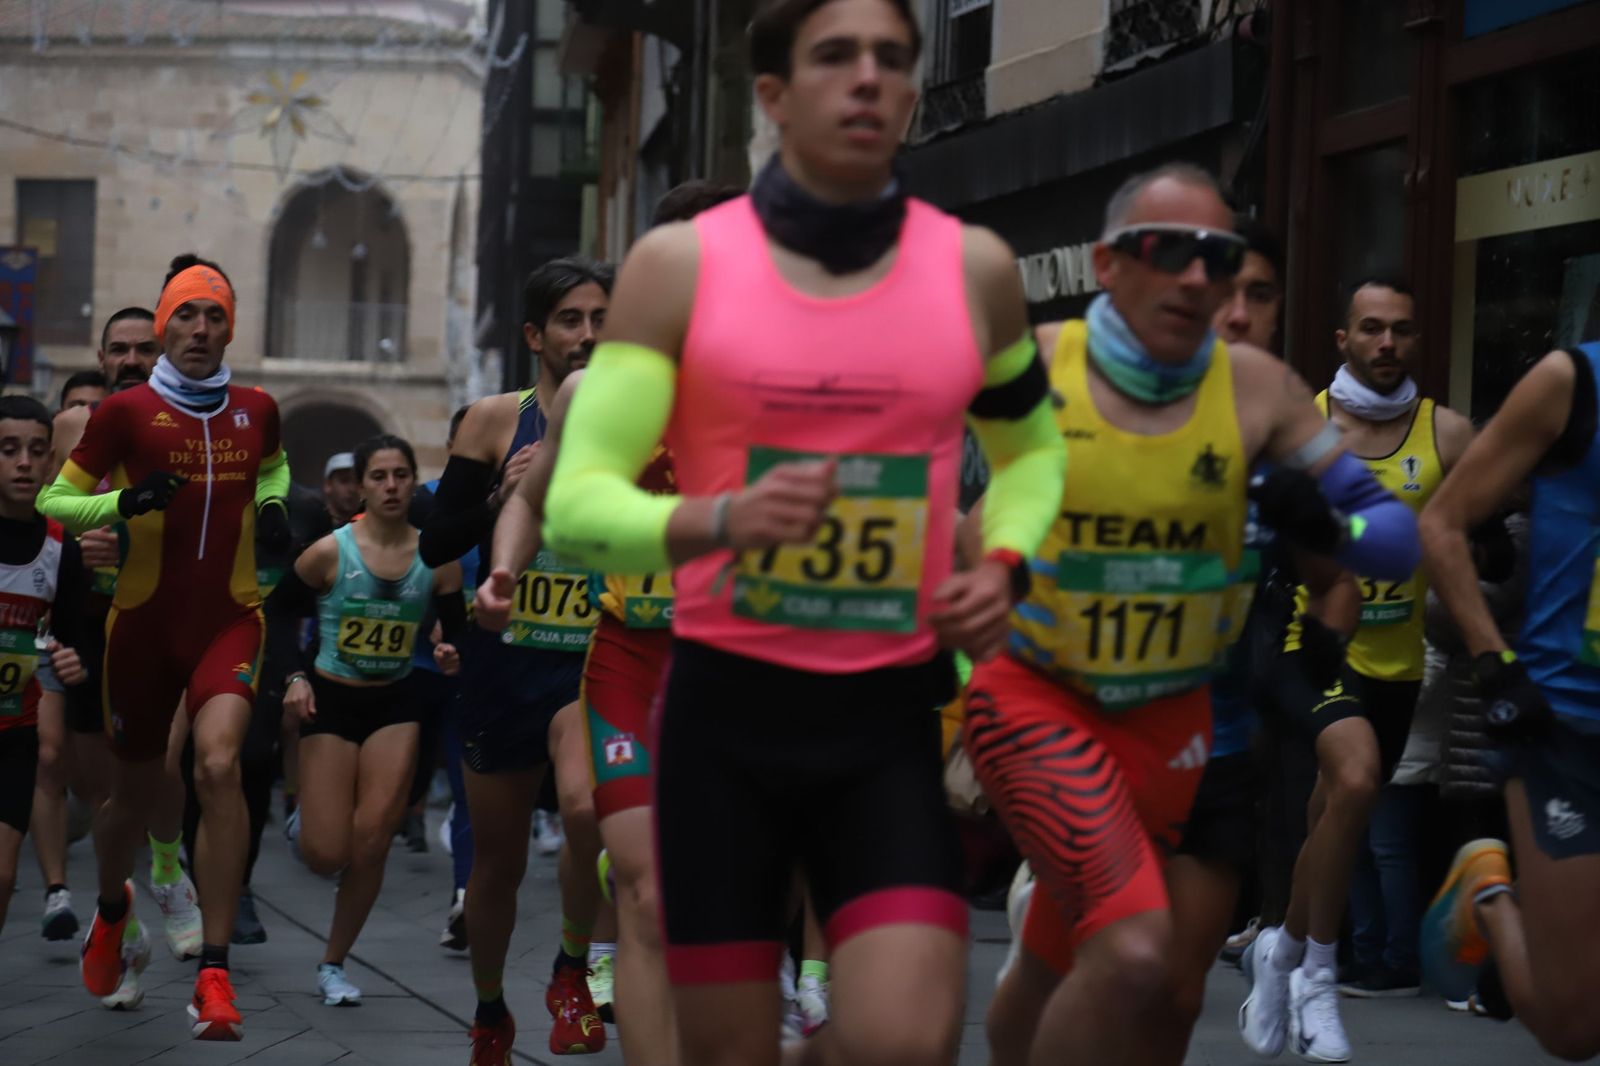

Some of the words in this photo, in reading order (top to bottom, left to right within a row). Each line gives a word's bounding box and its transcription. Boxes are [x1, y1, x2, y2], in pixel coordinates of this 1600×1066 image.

[169, 451, 192, 464] DE
[197, 449, 248, 464] TORO
[1061, 511, 1208, 549] TEAM
[516, 571, 592, 618] 1073
[342, 620, 406, 653] 249
[531, 630, 561, 644] CAJA
[1079, 601, 1186, 662] 1171
